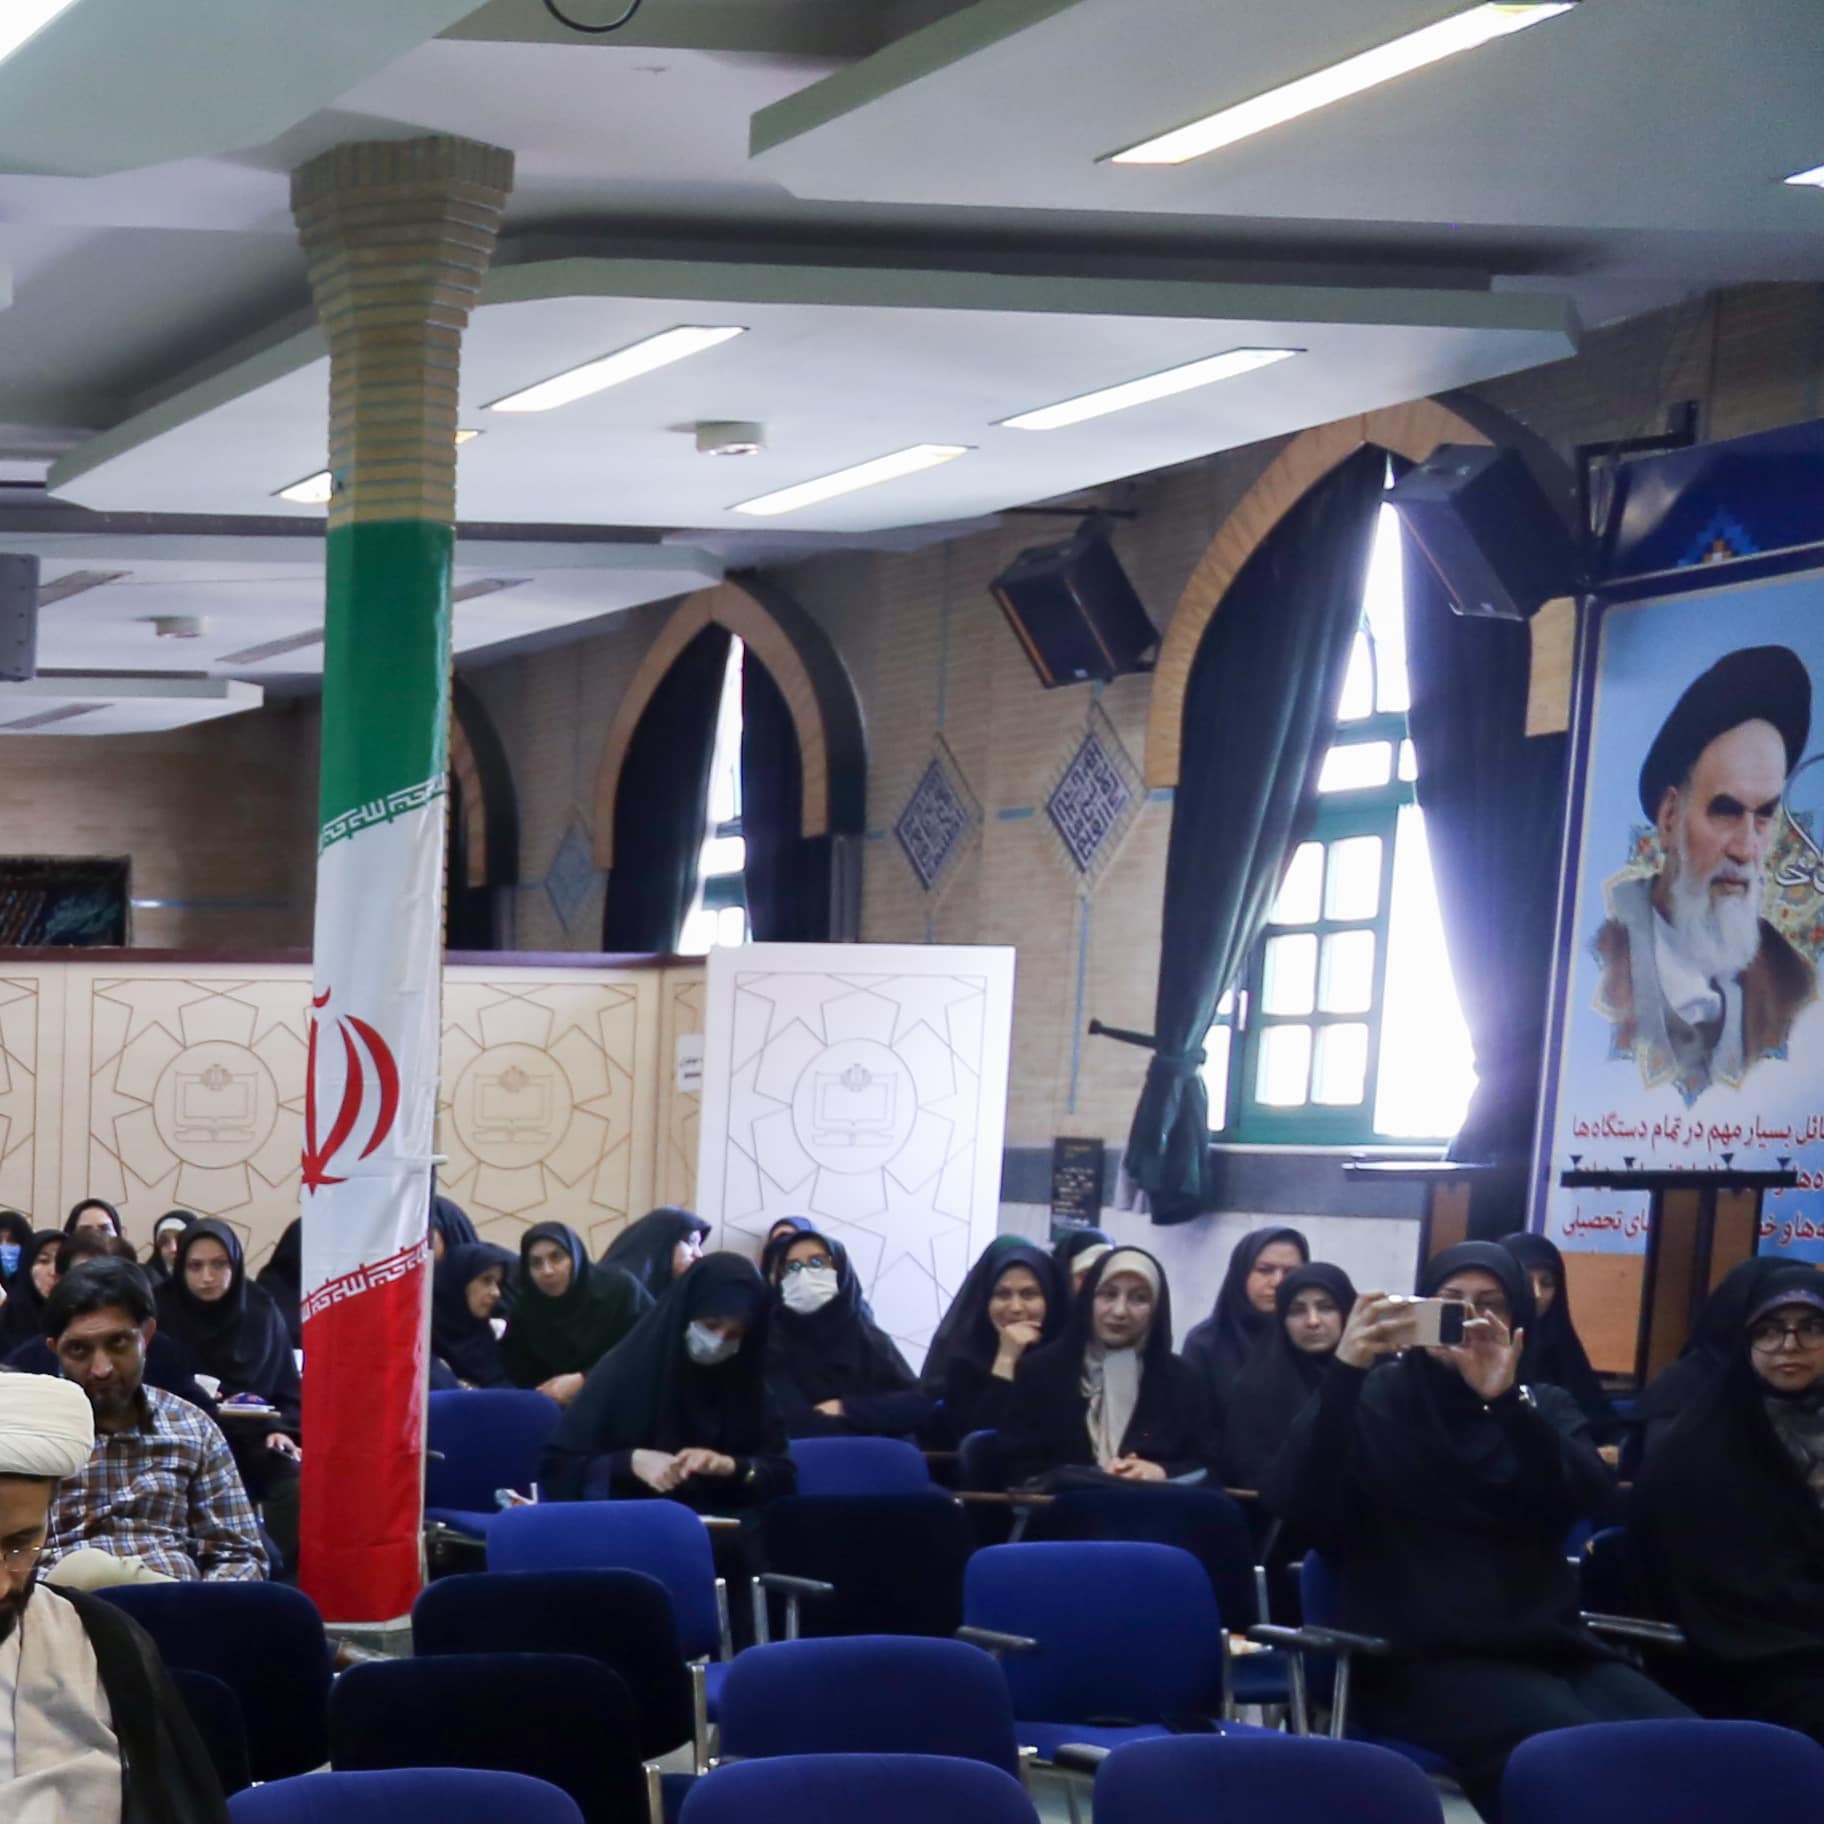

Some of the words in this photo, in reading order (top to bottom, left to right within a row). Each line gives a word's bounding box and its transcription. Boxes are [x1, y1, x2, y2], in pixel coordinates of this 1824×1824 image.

[1651, 1113, 1681, 1152] تمام
[1682, 1120, 1703, 1147] در
[1707, 1122, 1743, 1153] مهم
[1744, 1115, 1792, 1149] بسیار
[1561, 1204, 1622, 1237] تحصیلی
